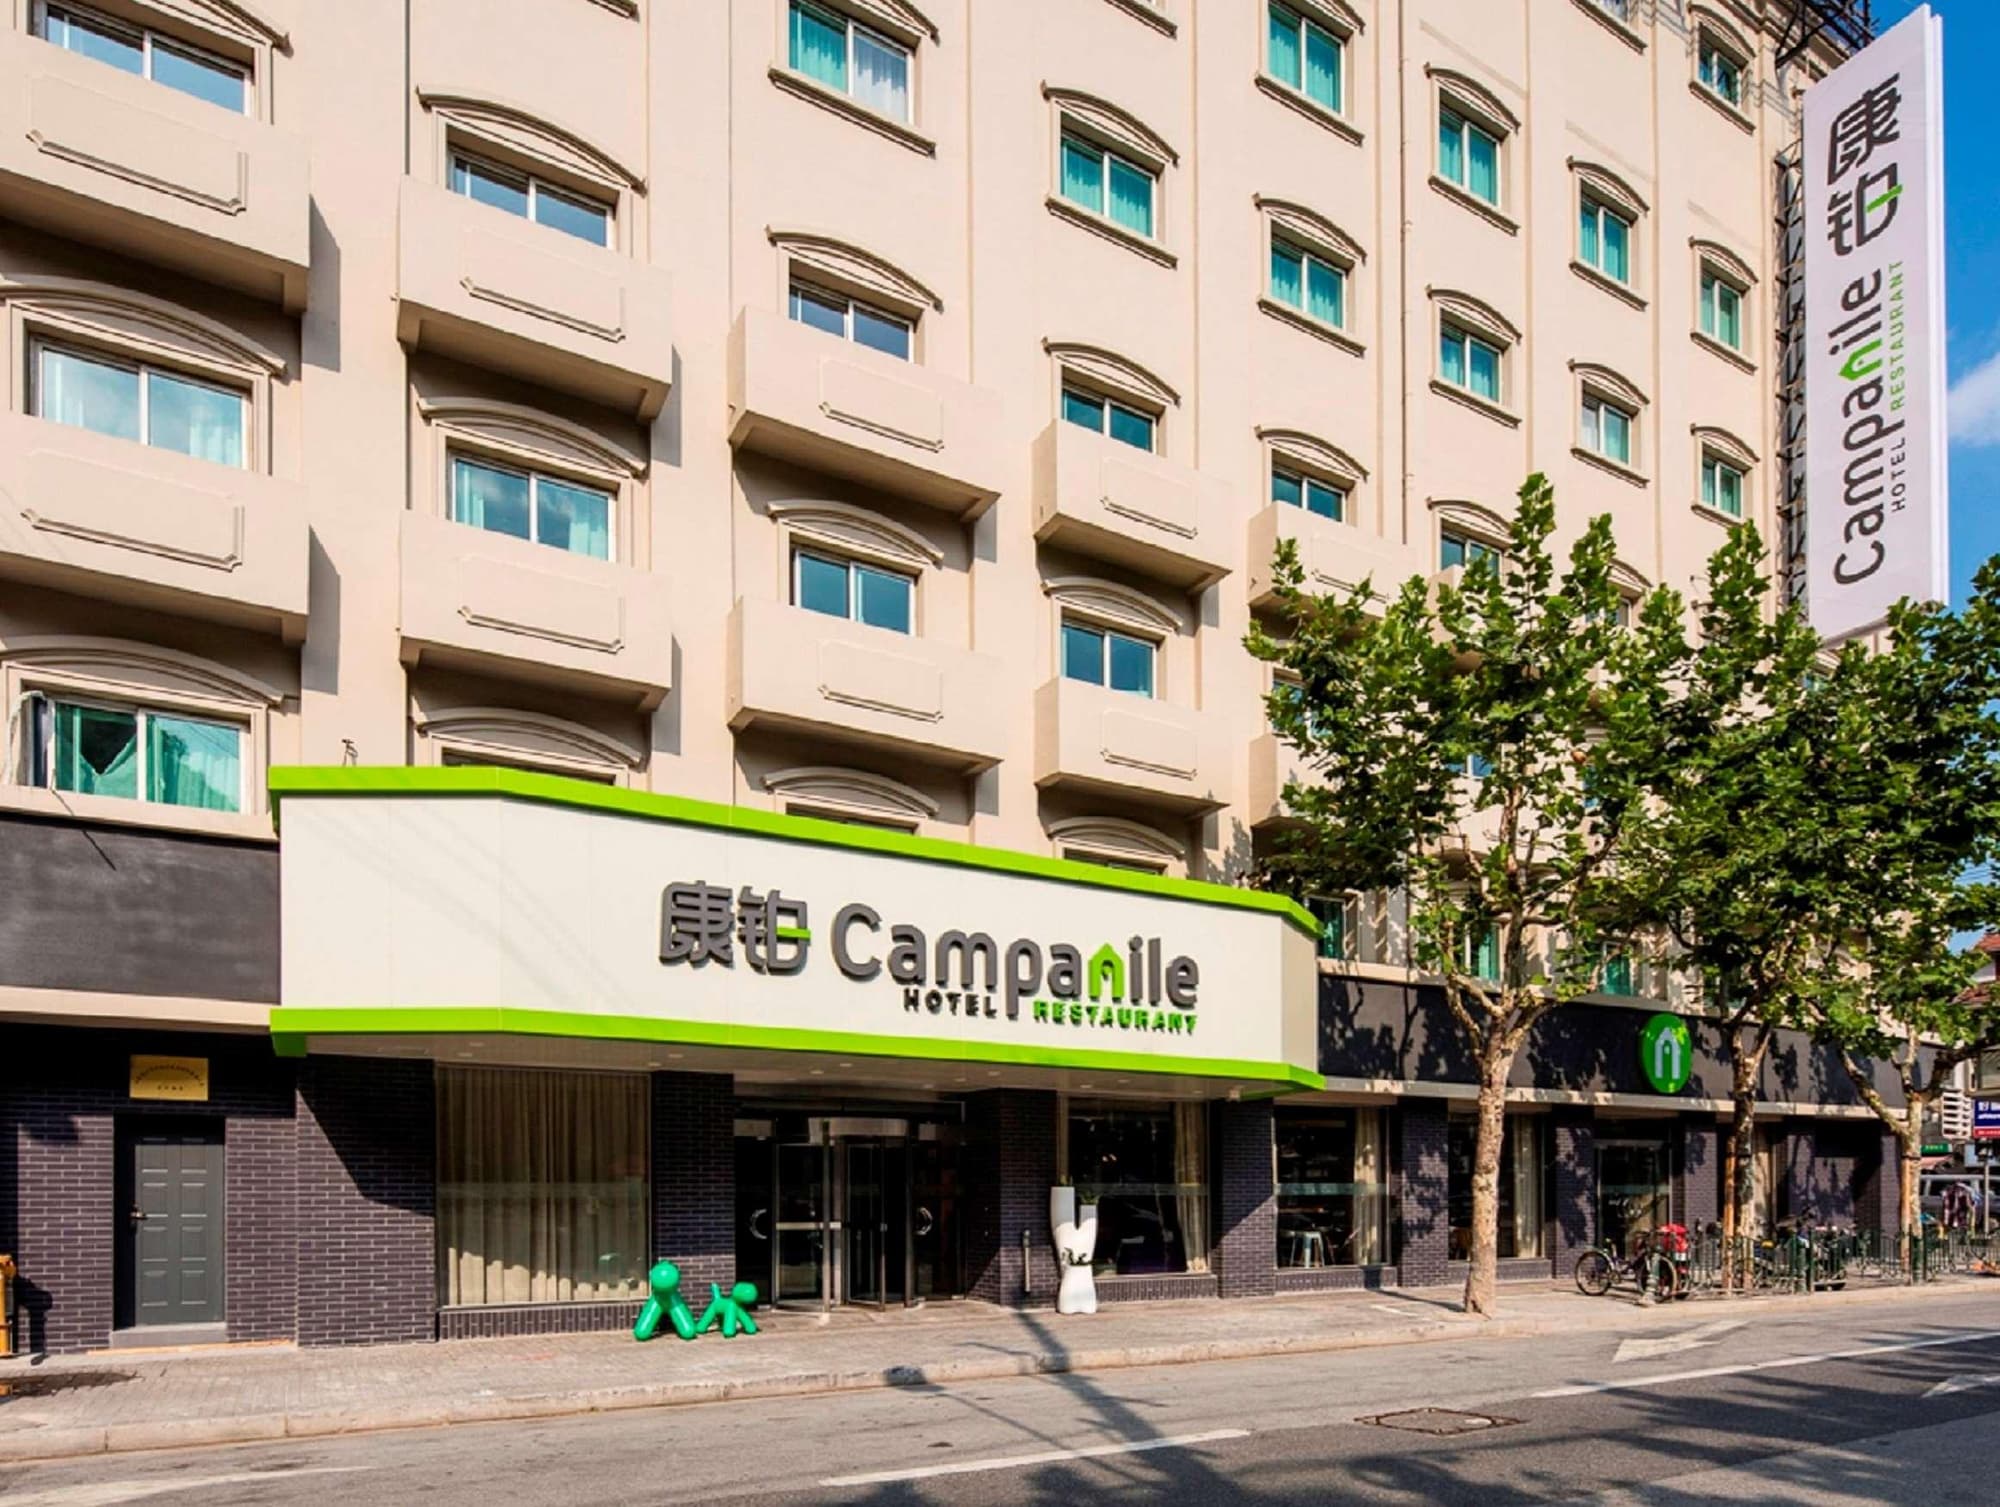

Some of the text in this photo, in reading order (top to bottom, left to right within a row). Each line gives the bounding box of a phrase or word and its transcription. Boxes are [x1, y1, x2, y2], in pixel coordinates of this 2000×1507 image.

[1827, 73, 1903, 257] 康铂
[1829, 268, 1904, 585] Campanile
[1889, 260, 1905, 512] HOTEL RESTAURANT
[660, 880, 811, 974] 康铂
[831, 903, 1199, 1018] Campanile
[903, 988, 1198, 1034] HOTEL RESTAURANT
